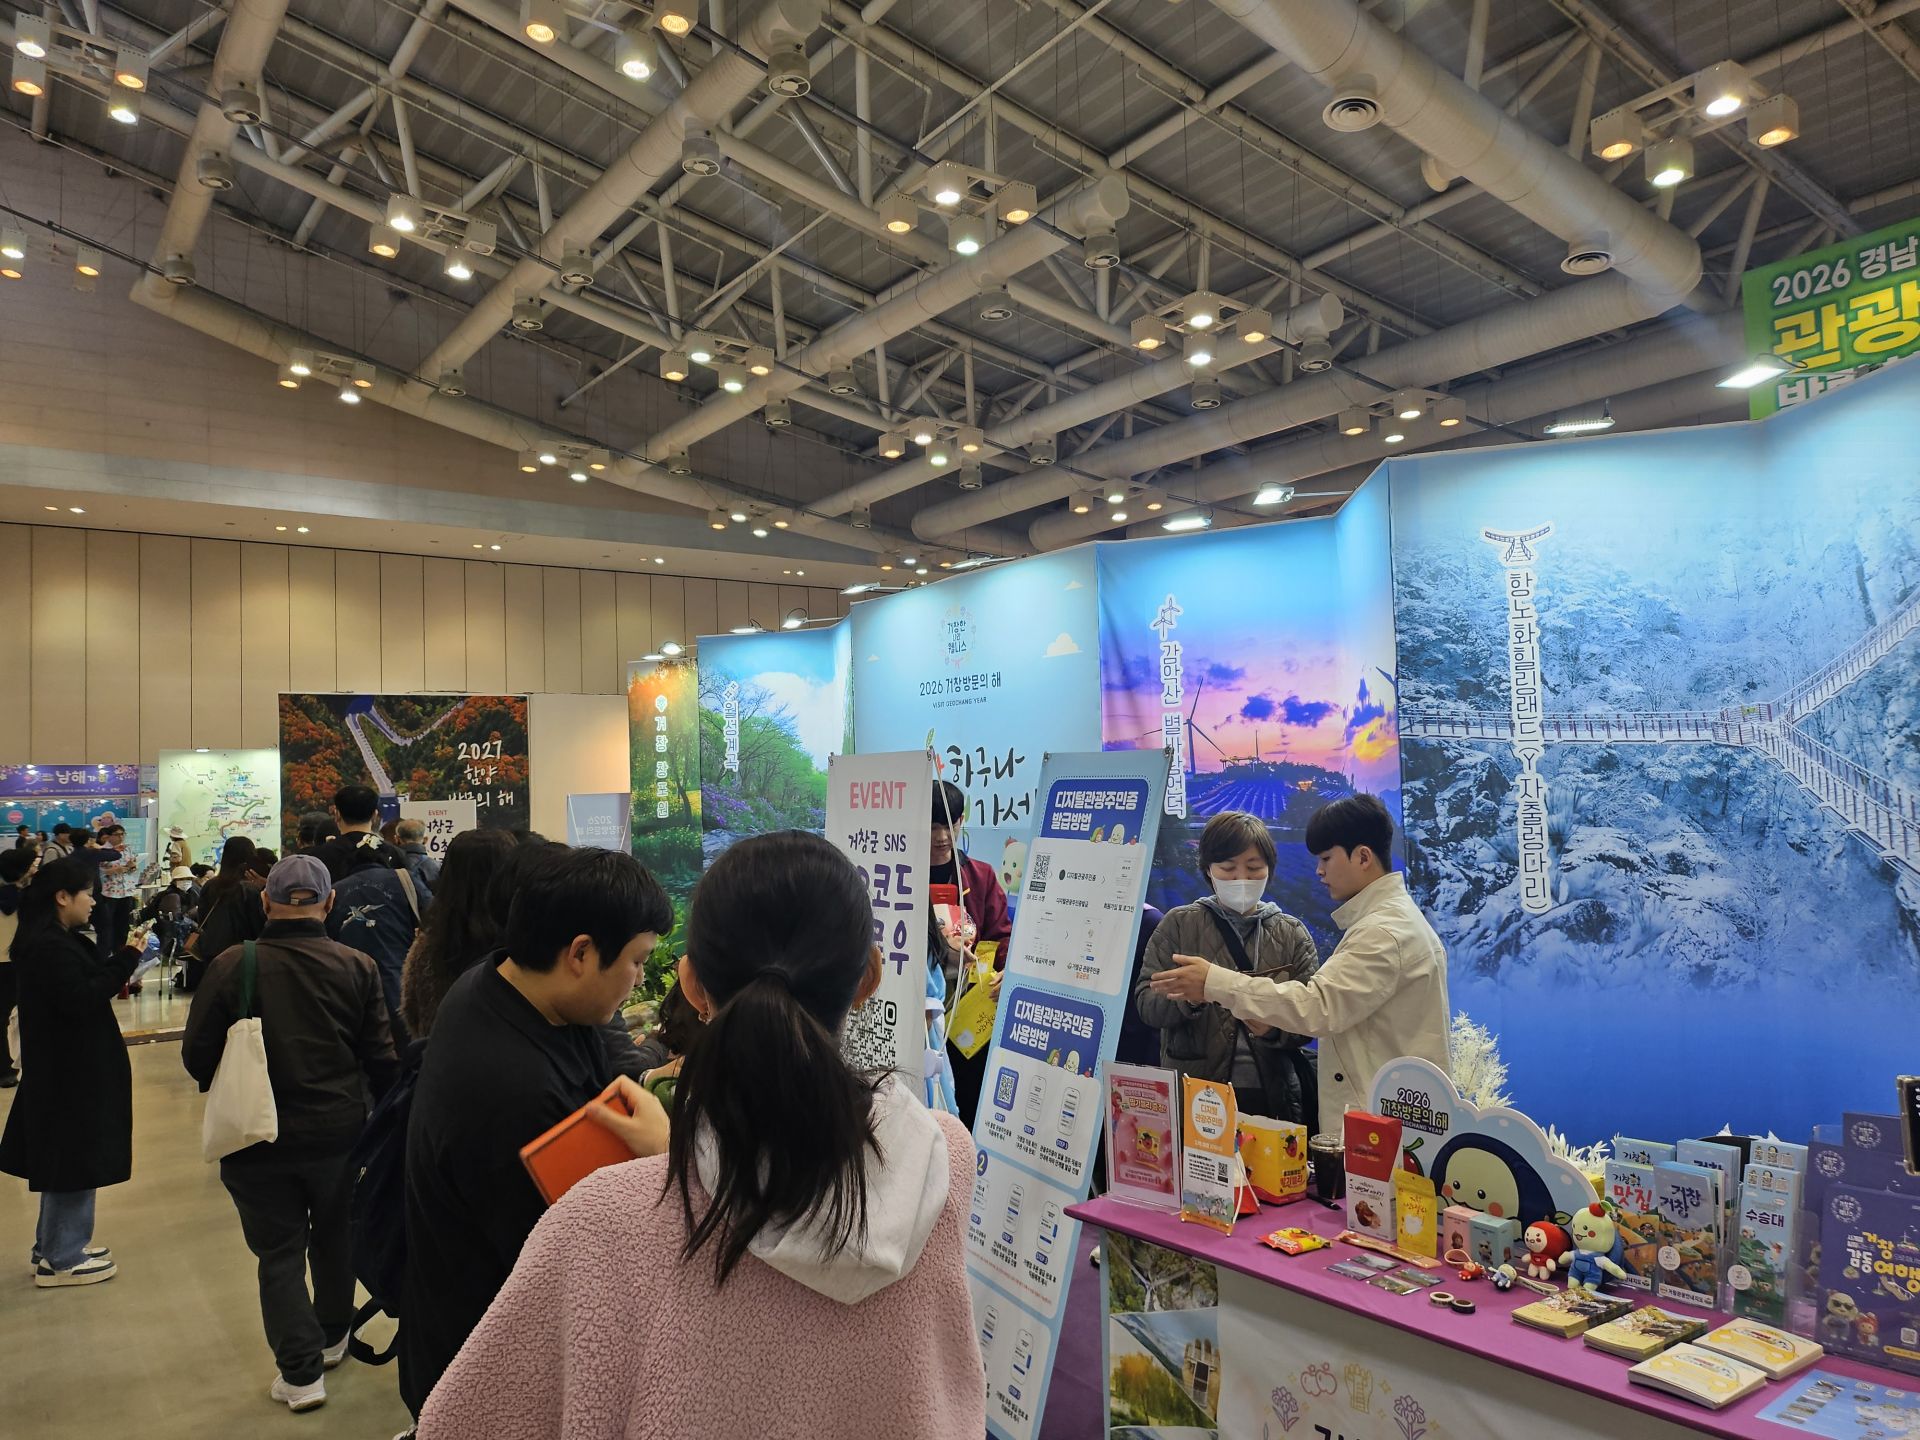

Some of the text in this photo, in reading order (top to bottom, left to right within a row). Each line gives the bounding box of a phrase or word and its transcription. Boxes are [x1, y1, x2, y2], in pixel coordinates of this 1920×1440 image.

[1773, 236, 1918, 305] 2026 경남
[920, 671, 1001, 696] 2026 거창방문의 해
[1163, 644, 1181, 706] 감악산
[725, 702, 738, 772] 월성계곡
[457, 740, 502, 760] 2027
[464, 764, 498, 785] 함양
[497, 790, 513, 806] 해
[850, 781, 907, 809] EVENT
[1055, 790, 1138, 810] 디지털관광주민증
[1051, 812, 1092, 832] 발급방법
[848, 828, 907, 853] 거창군 SNS
[857, 863, 914, 910] 코드
[1015, 999, 1094, 1039] 디지털관광주민증
[1009, 1022, 1050, 1051] 사용방법
[1398, 1088, 1429, 1109] 2026
[1381, 1099, 1448, 1129] 거창방문의 해
[1613, 1185, 1652, 1211] 맛집
[1660, 1196, 1689, 1219] 거창
[1671, 1185, 1701, 1208] 거창
[1745, 1209, 1785, 1228] 수승대
[1862, 1231, 1895, 1260] 거창
[1846, 1248, 1873, 1274] 감동
